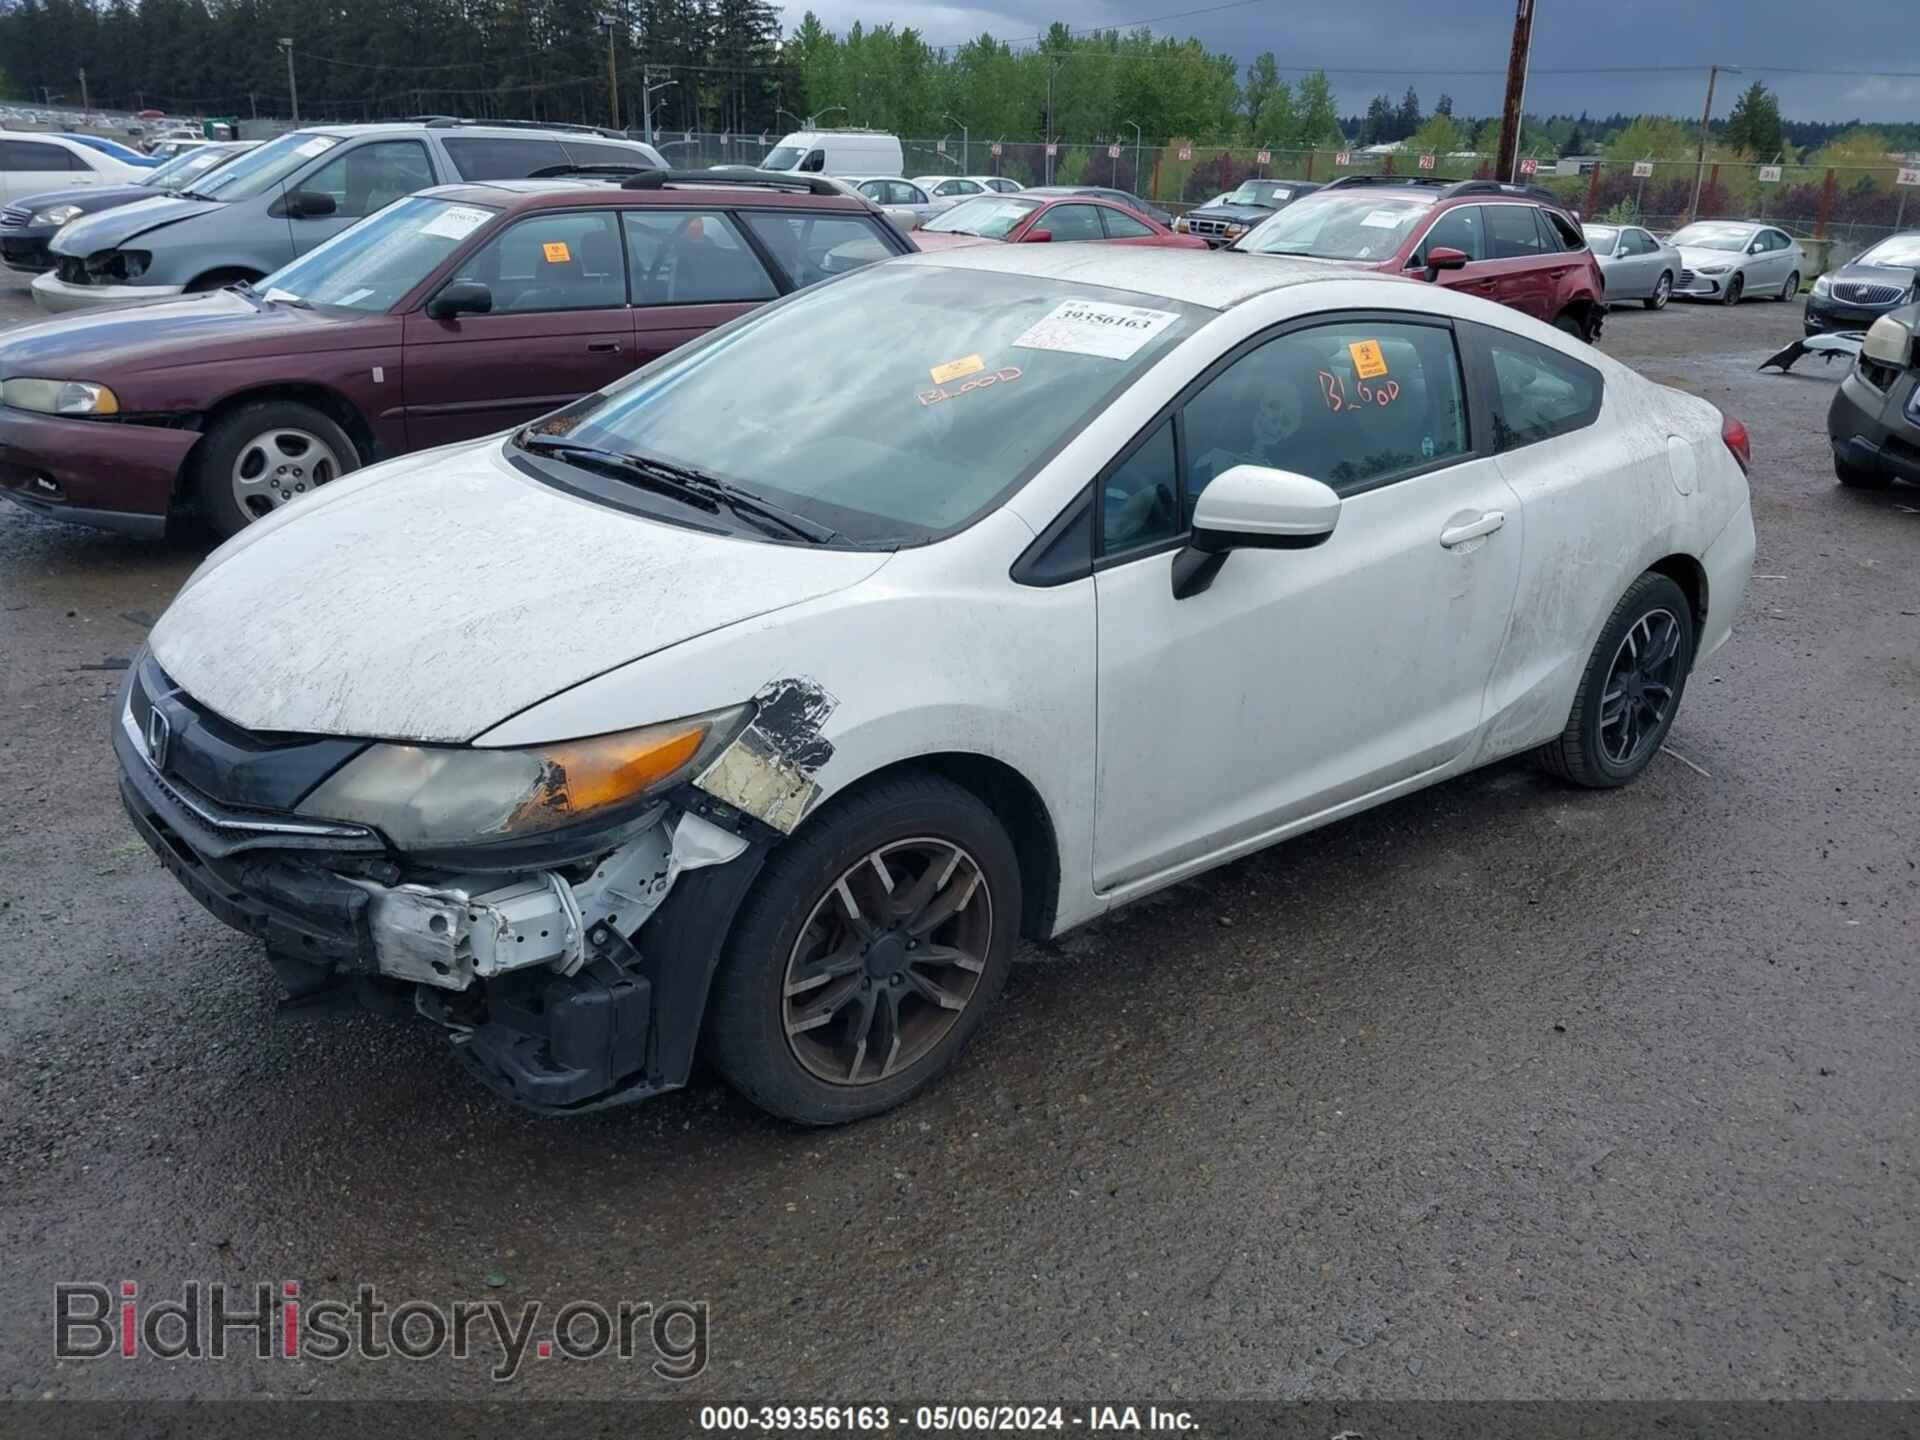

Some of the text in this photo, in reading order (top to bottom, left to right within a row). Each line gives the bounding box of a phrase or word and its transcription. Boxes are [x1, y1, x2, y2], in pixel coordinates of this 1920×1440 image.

[1522, 160, 1536, 173] 29
[1057, 309, 1151, 330] 39356163
[919, 367, 1022, 405] BLOOD
